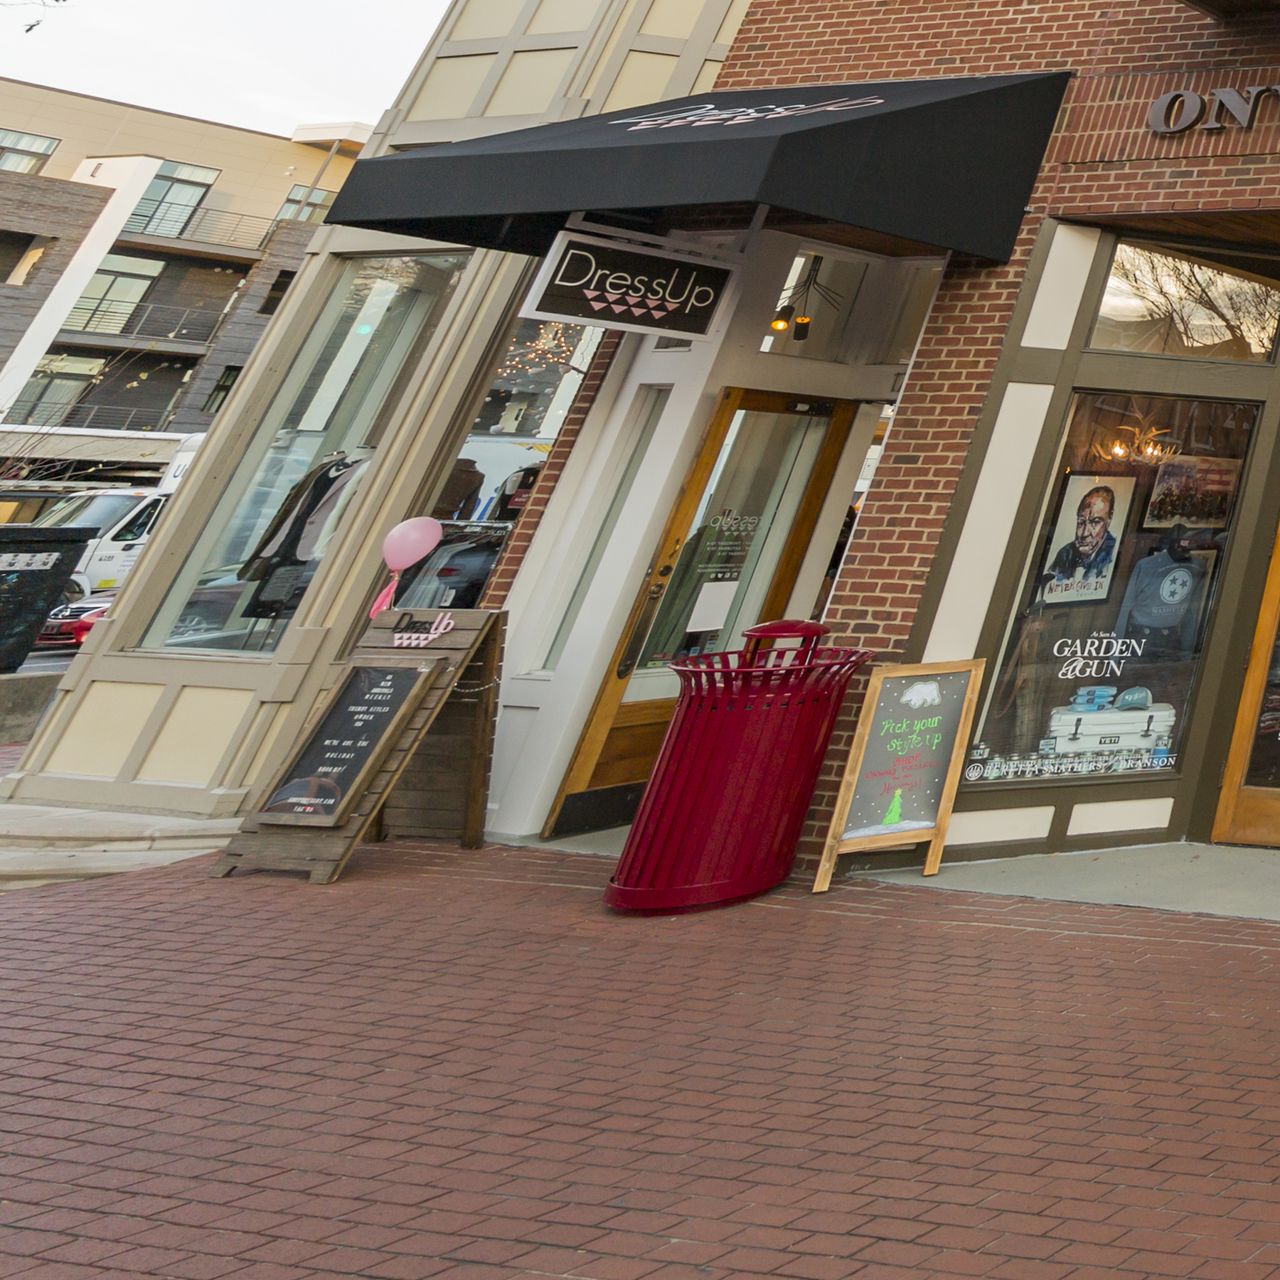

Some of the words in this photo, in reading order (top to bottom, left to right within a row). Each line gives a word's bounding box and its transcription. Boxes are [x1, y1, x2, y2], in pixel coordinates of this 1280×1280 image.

[554, 249, 715, 314] DressUp
[1053, 638, 1147, 657] GARDEN
[880, 718, 911, 737] Pick
[912, 716, 942, 735] your
[983, 764, 1040, 778] BERETTA
[1042, 761, 1102, 774] SMATHERS
[1119, 757, 1177, 769] BRANSON
